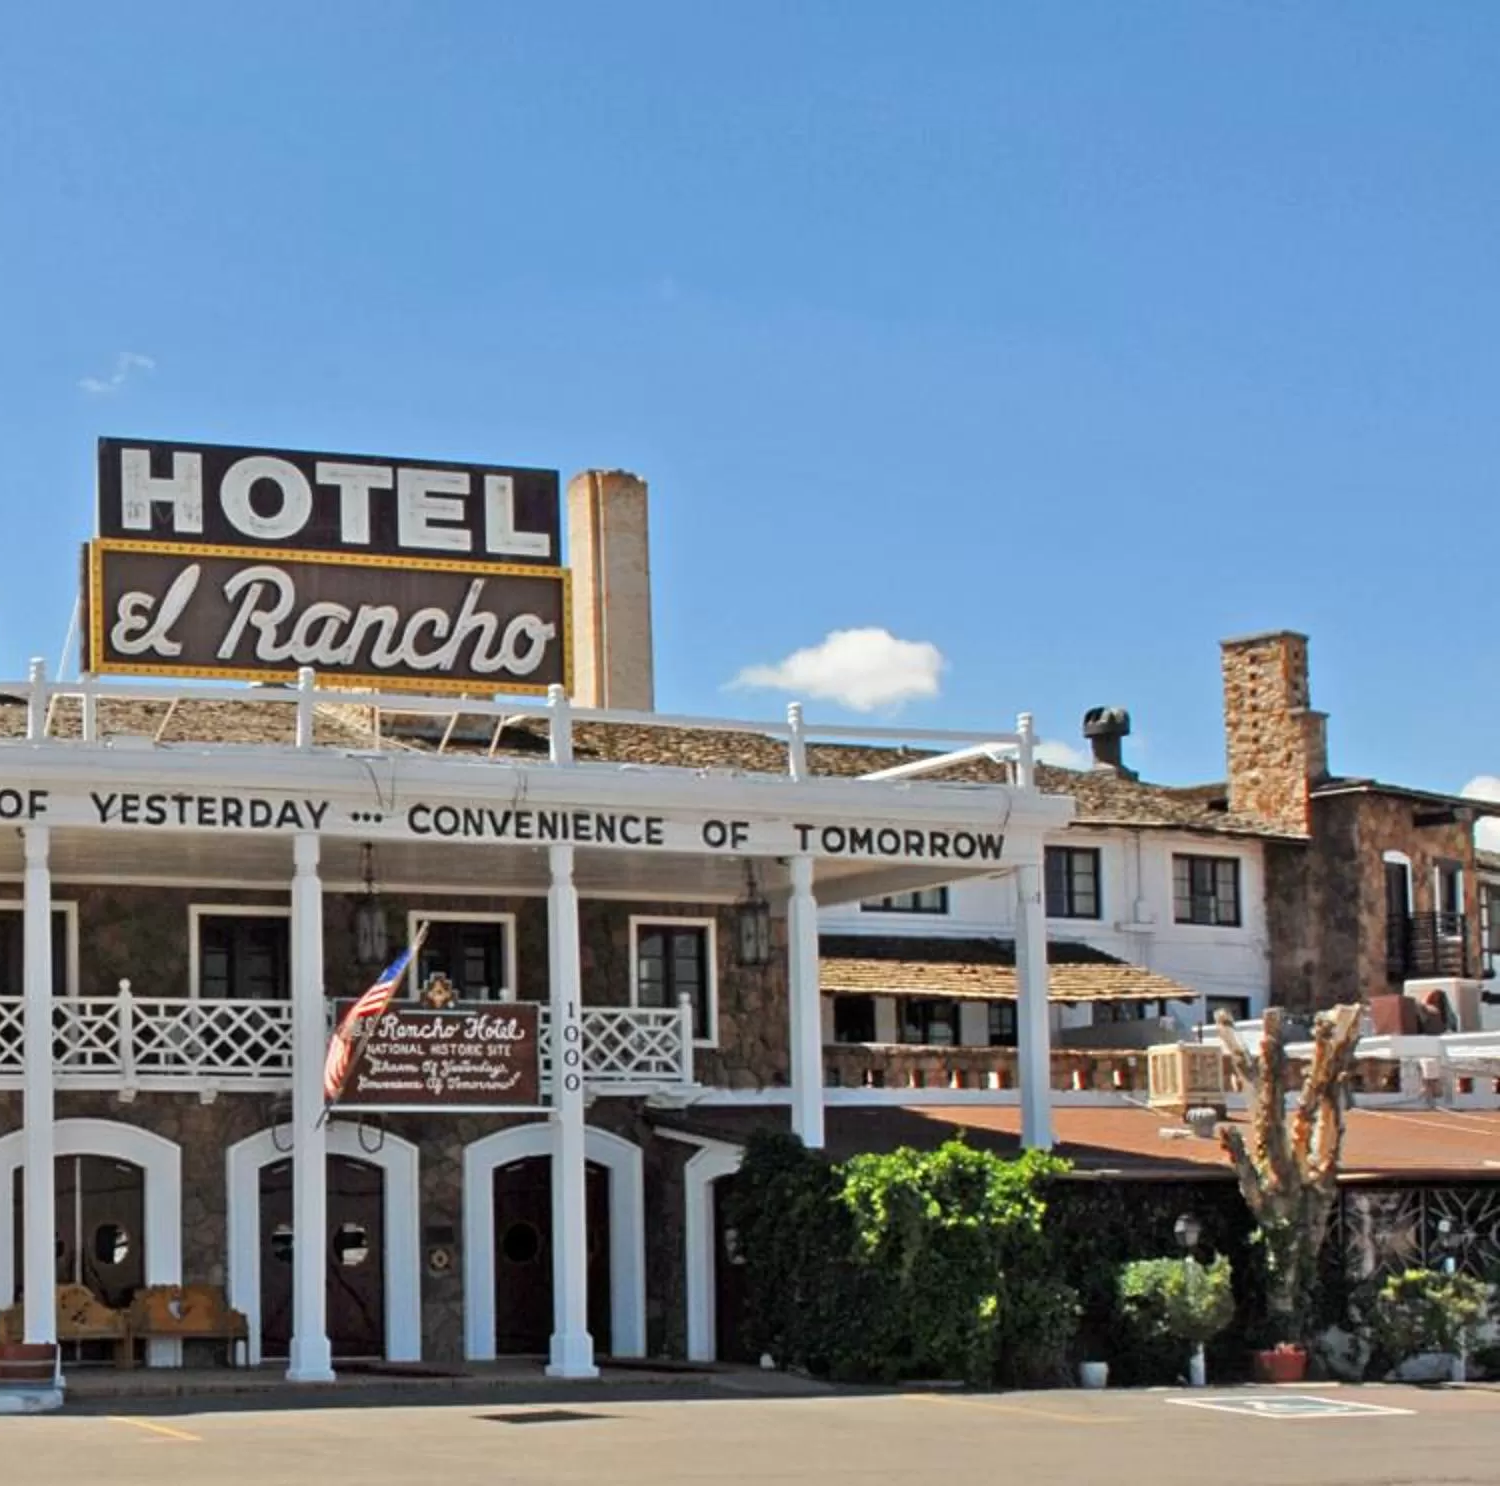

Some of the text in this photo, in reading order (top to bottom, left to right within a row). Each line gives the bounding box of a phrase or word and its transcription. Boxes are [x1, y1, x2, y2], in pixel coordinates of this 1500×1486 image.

[120, 446, 551, 557] HOTEL
[111, 563, 555, 676] El Rancho
[90, 791, 329, 830] YESTERDAY
[407, 803, 665, 846] CONVENIENCE
[702, 819, 751, 849] OF
[794, 822, 1006, 861] TOMORROW
[367, 1043, 513, 1057] NATIONAL HISTORIC SITE
[378, 1013, 460, 1040] Rancho
[463, 1013, 526, 1041] Hotel
[563, 1001, 581, 1092] 1000
